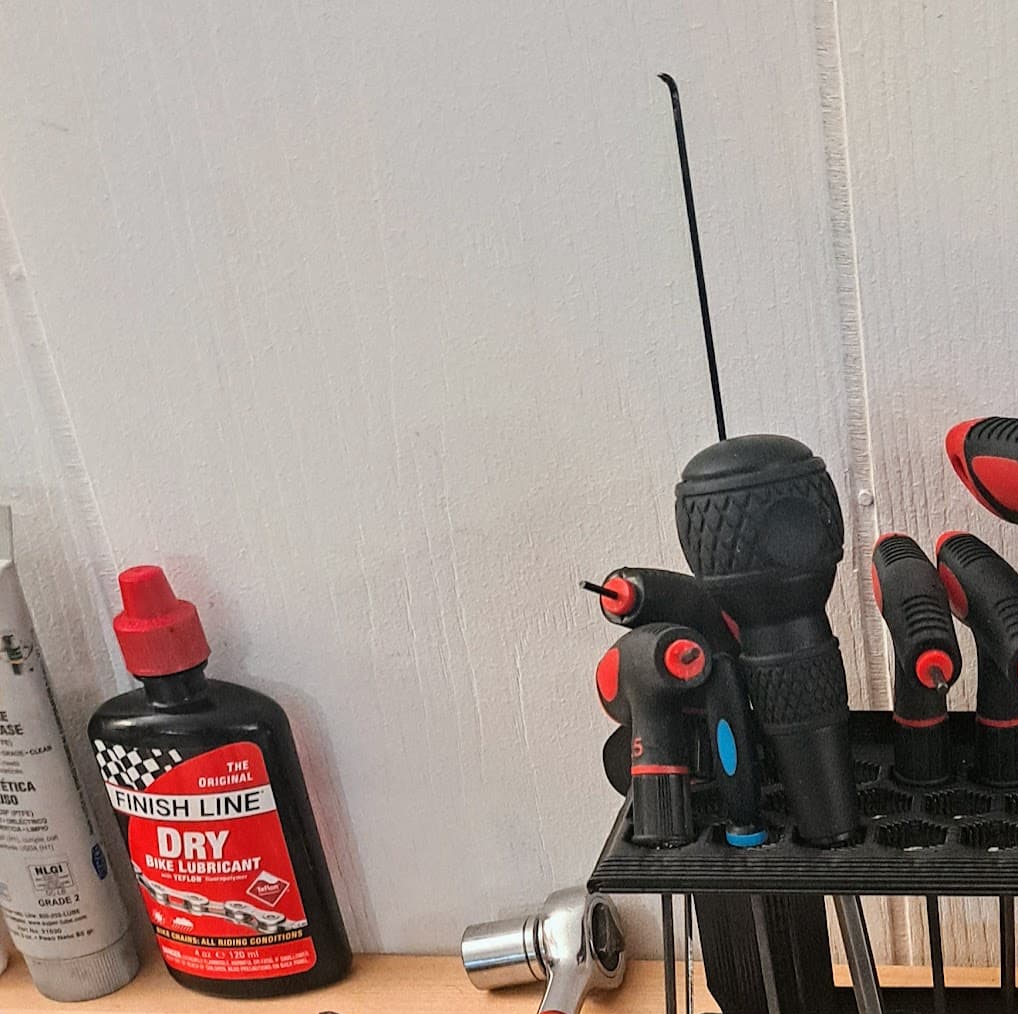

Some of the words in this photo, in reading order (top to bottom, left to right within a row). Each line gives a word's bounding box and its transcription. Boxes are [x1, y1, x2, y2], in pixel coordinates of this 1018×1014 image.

[226, 760, 249, 773] THE
[198, 772, 254, 788] ORIGINAL
[115, 790, 189, 817] FINISH
[200, 791, 261, 817] LINE
[156, 826, 230, 860] DRY
[145, 854, 174, 872] BIKE
[177, 856, 262, 875] LUBRICANT
[38, 896, 72, 908] GRADE
[200, 937, 216, 947] ALL
[218, 937, 248, 947] RIDING
[250, 930, 303, 946] CONDITIONS
